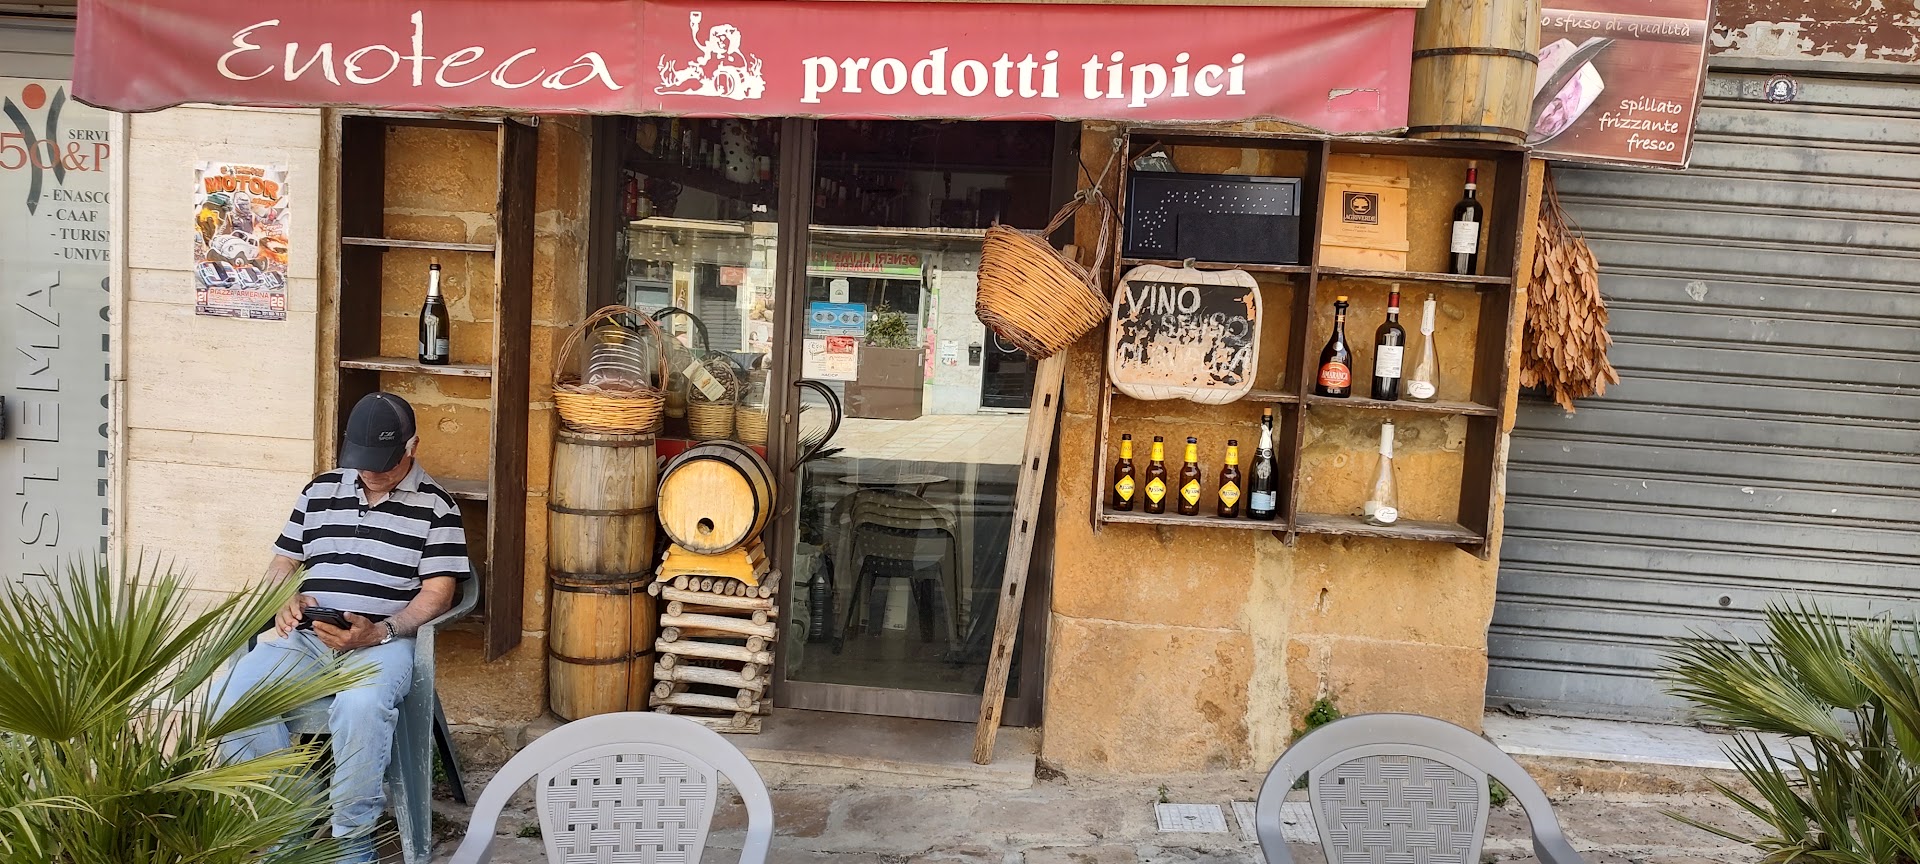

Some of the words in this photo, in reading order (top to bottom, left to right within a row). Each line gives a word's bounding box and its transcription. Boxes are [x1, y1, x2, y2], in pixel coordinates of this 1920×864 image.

[1555, 14, 1600, 32] sfuso
[1605, 17, 1623, 31] di
[1628, 22, 1691, 37] qualità
[216, 8, 624, 91] Enoteca
[800, 46, 1060, 104] prodotti
[1081, 51, 1247, 108] tipici
[1620, 96, 1682, 115] spillato
[1599, 112, 1679, 133] frizzante
[1627, 133, 1675, 152] fresco
[204, 174, 279, 201] MOTOR
[56, 208, 99, 222] CAAF
[197, 292, 207, 303] 21
[271, 296, 284, 308] 26
[1125, 284, 1201, 315] VINO
